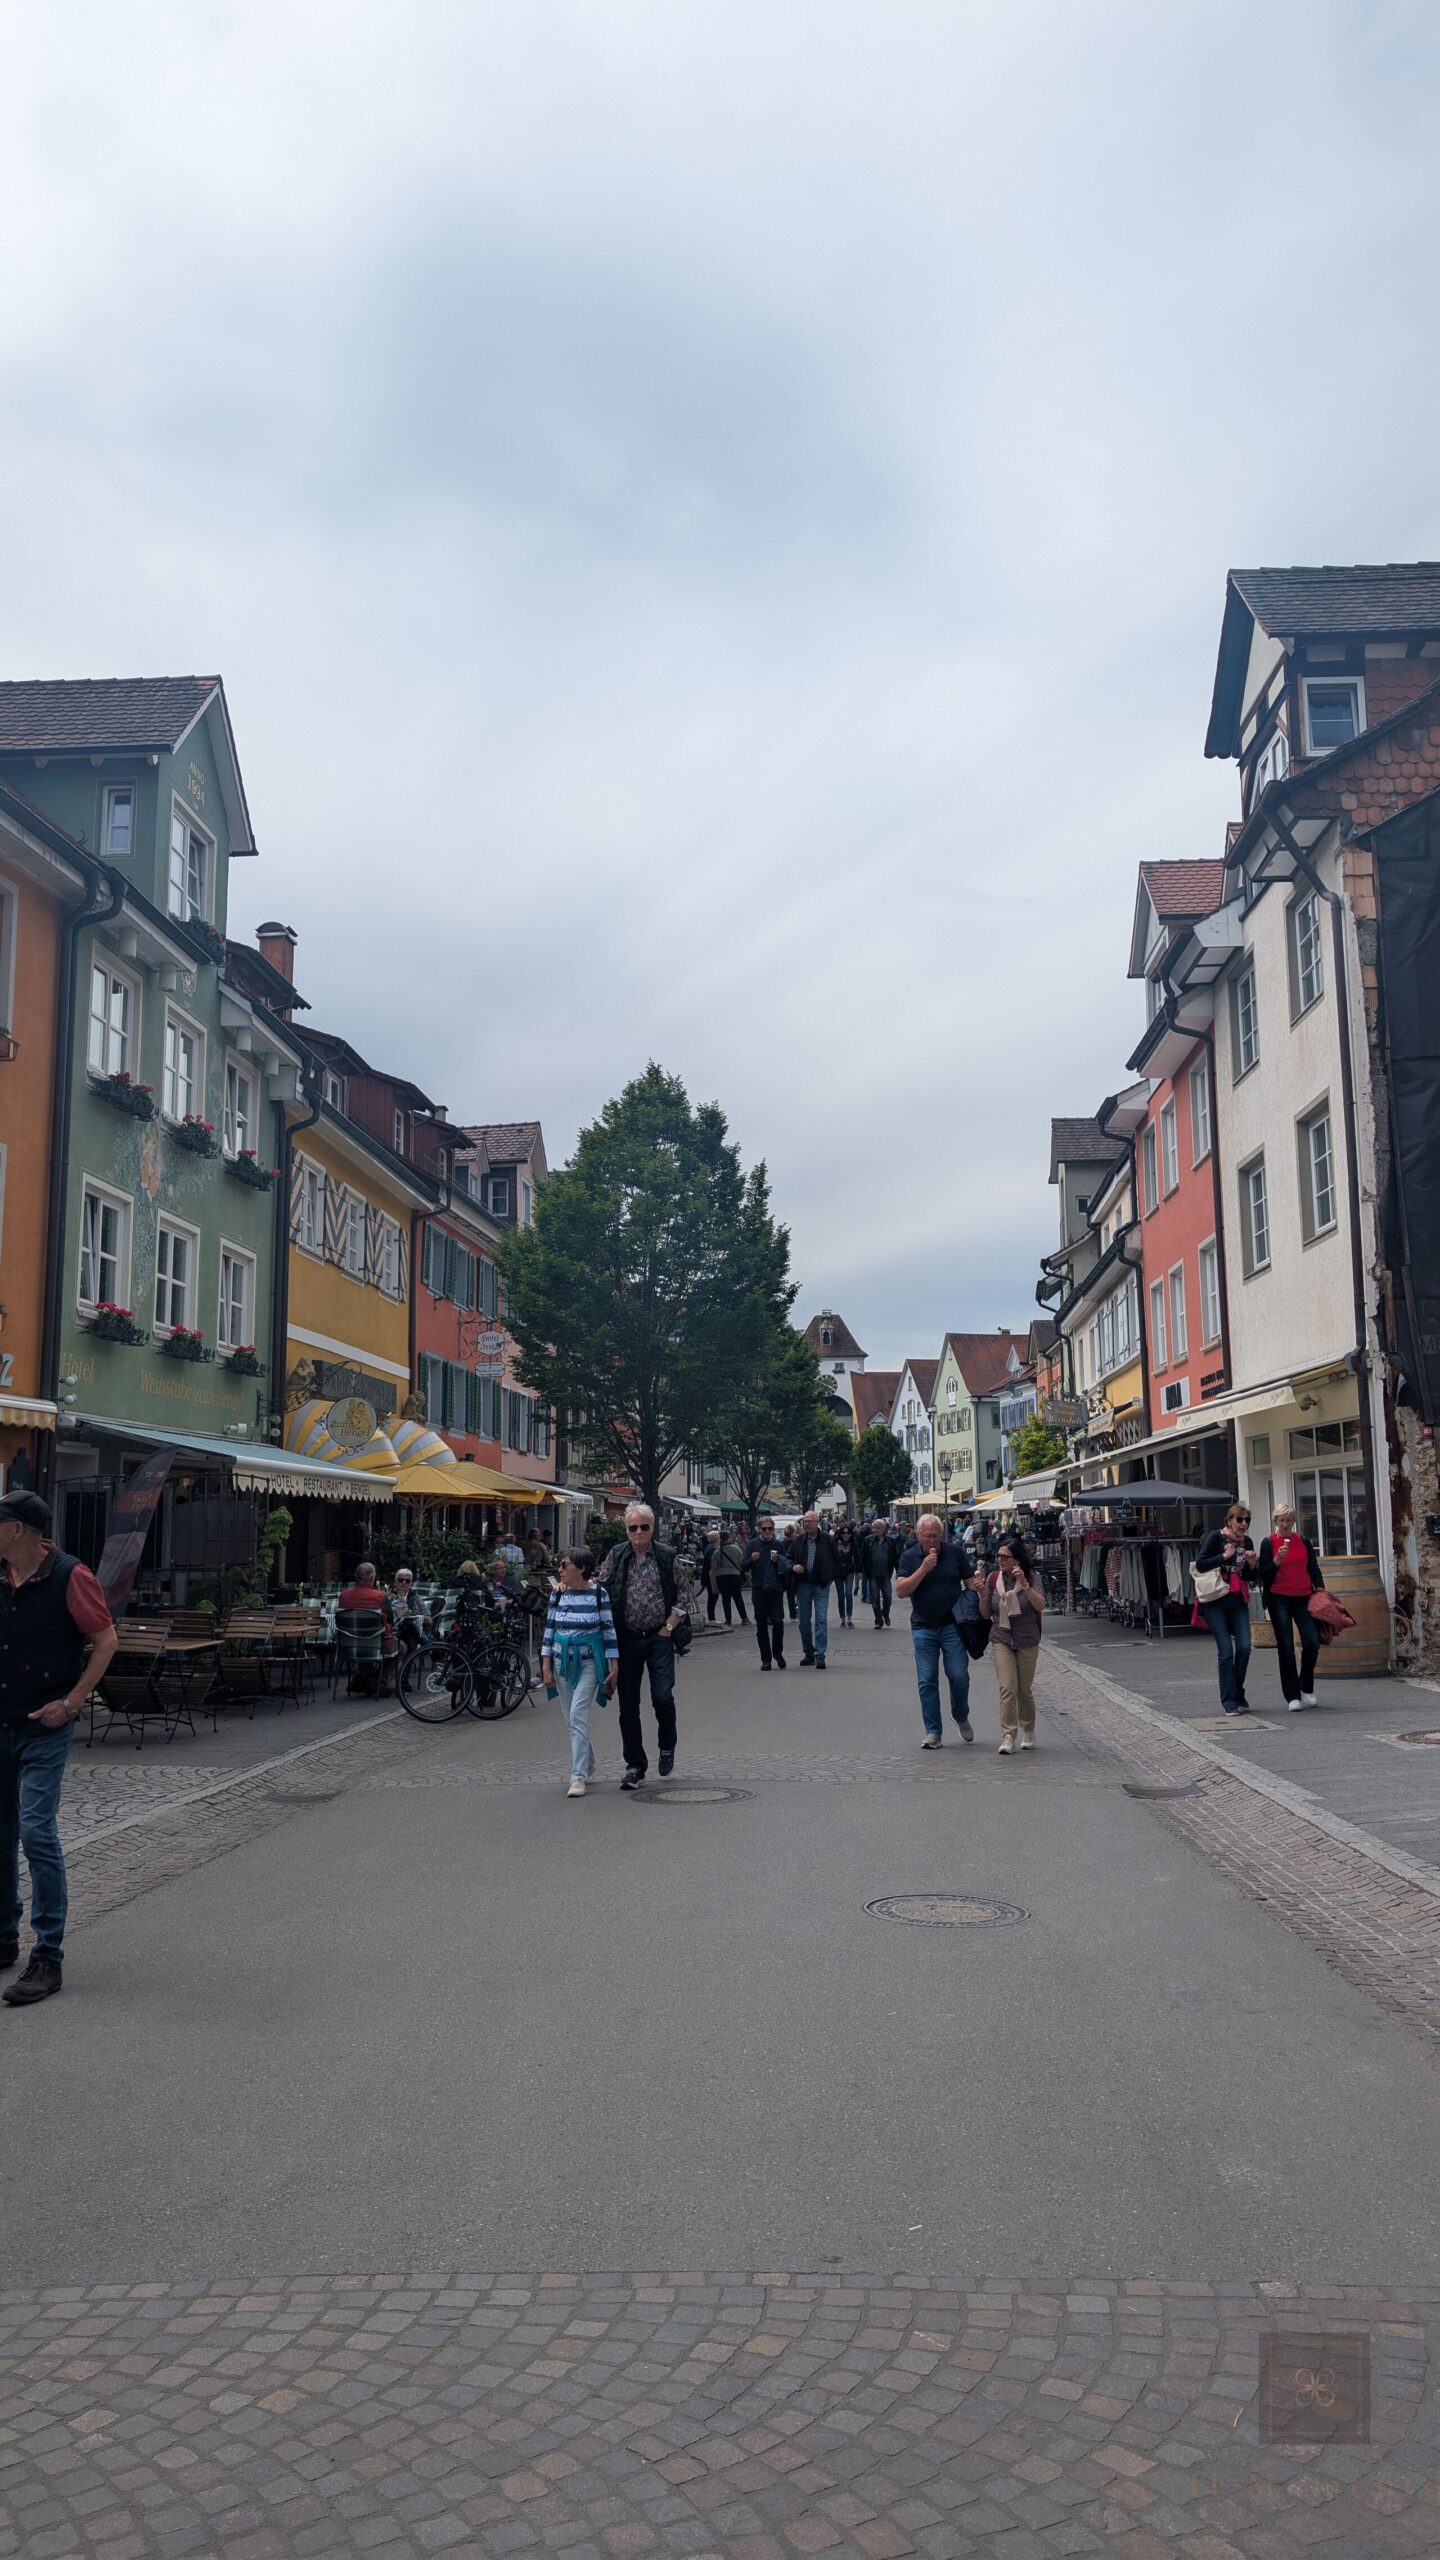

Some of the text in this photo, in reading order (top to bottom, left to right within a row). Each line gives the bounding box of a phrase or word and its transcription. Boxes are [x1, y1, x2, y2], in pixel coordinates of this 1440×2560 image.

[61, 1352, 95, 1382] Hotel
[140, 1369, 194, 1401] Weinstube
[194, 1388, 215, 1406] zum
[340, 1428, 370, 1438] Bengel
[271, 1474, 371, 1497] HOTEL RESTAURANT BENGEL
